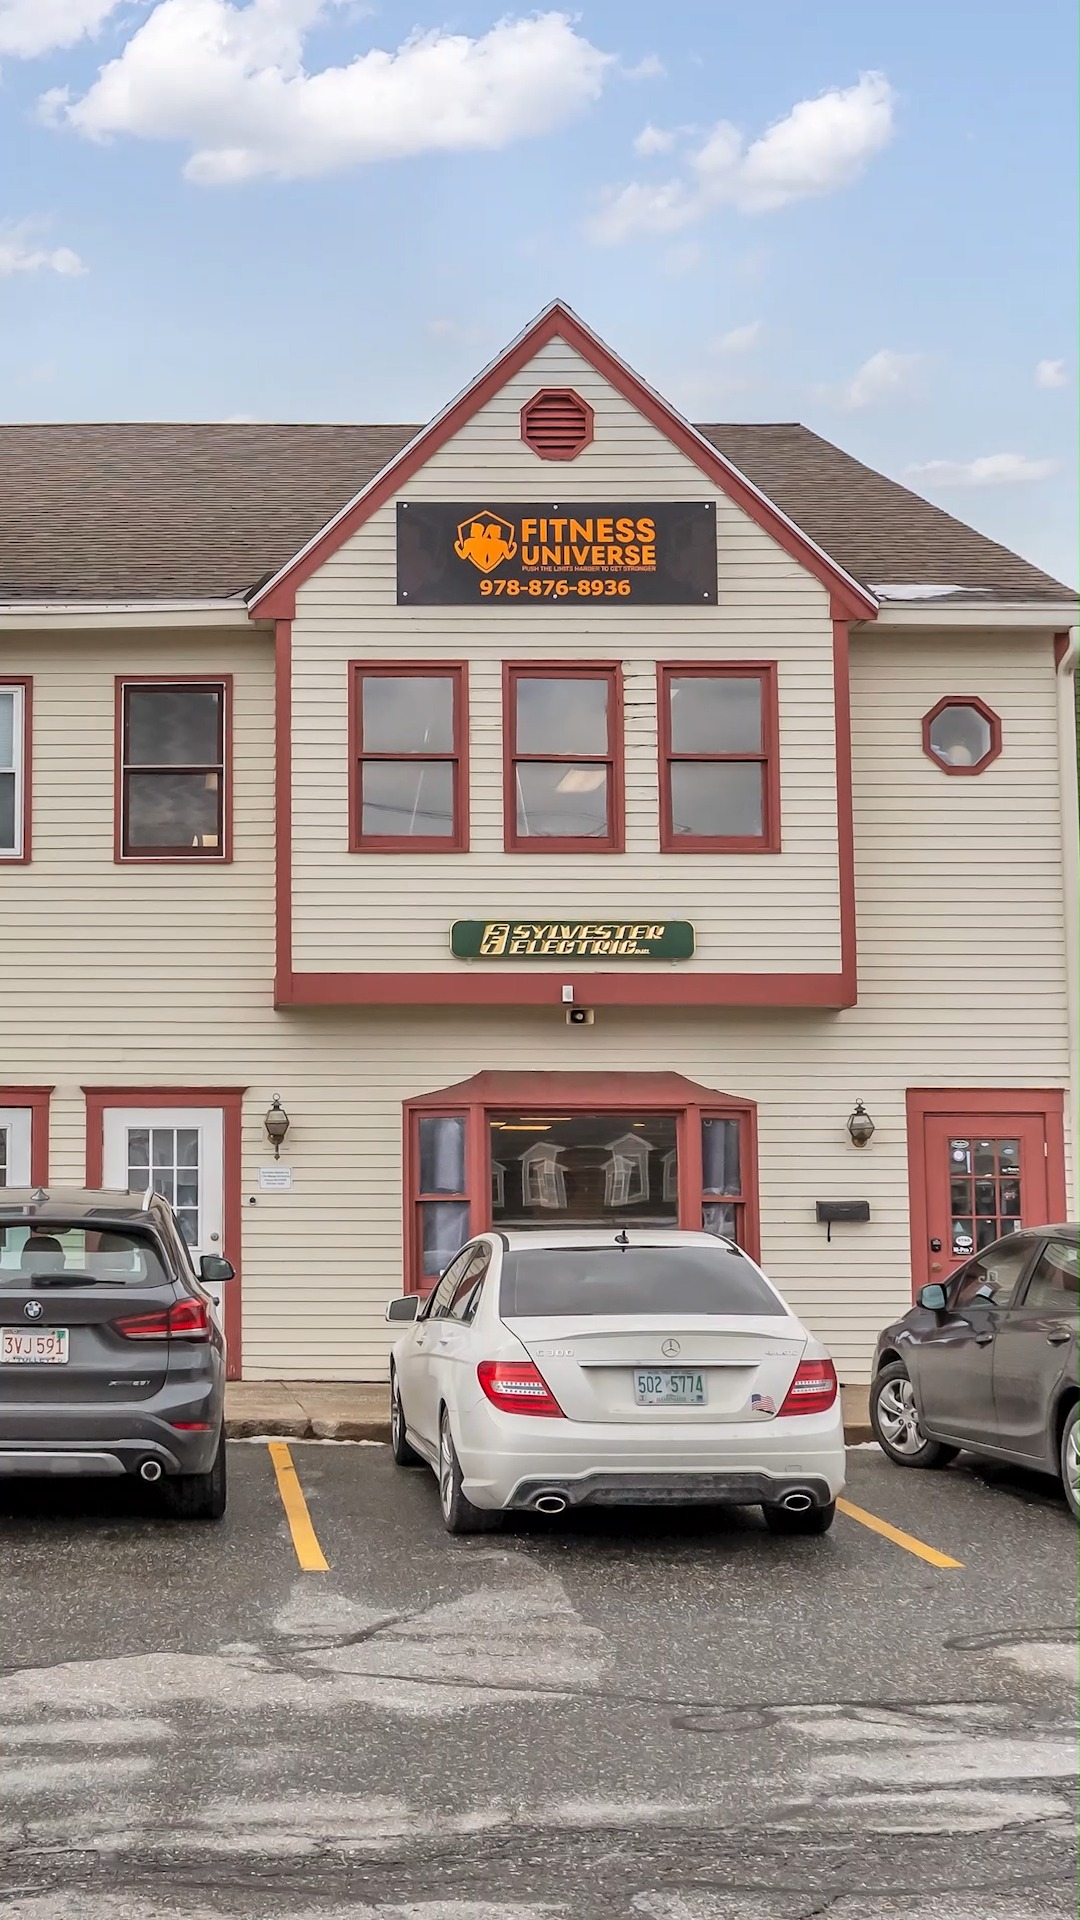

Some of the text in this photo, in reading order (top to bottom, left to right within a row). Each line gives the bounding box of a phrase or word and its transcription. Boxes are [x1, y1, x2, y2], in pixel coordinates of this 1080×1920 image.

[522, 518, 656, 543] FITNESS
[522, 545, 657, 566] UNIVERSE
[479, 579, 631, 596] 978-876-8936
[512, 924, 665, 939] SYLVESTER
[509, 939, 637, 955] ELECTRIC
[5, 1337, 64, 1355] 3VJ 591
[536, 1349, 575, 1357] C 300
[638, 1375, 703, 1393] 502 5774
